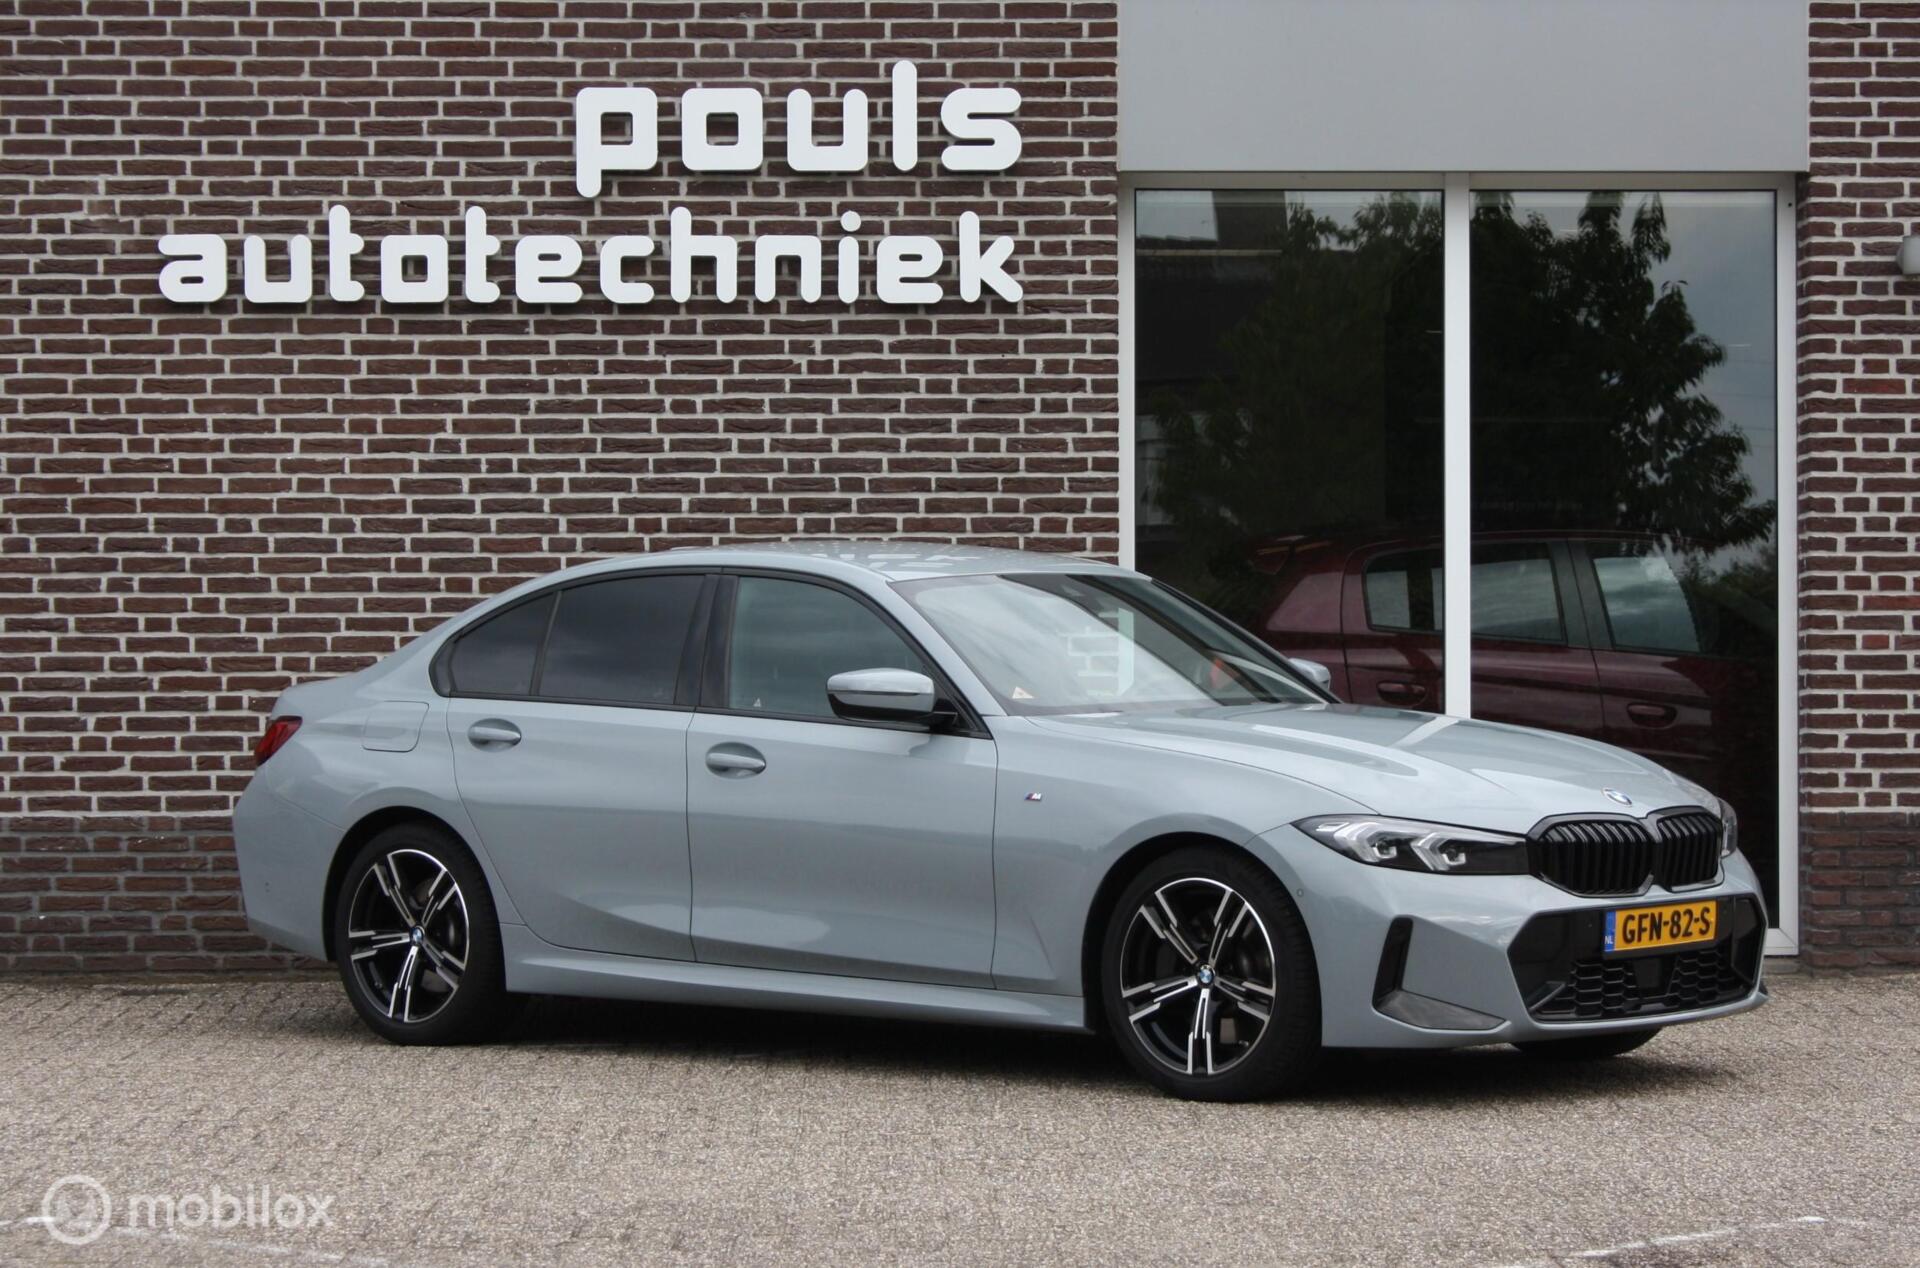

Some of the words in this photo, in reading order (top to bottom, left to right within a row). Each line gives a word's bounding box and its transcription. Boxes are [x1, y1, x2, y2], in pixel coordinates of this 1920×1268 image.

[576, 60, 1022, 197] pouls
[158, 205, 1024, 304] autotechniek
[1604, 935, 1614, 945] NL
[1622, 906, 1711, 944] GFN-82-S
